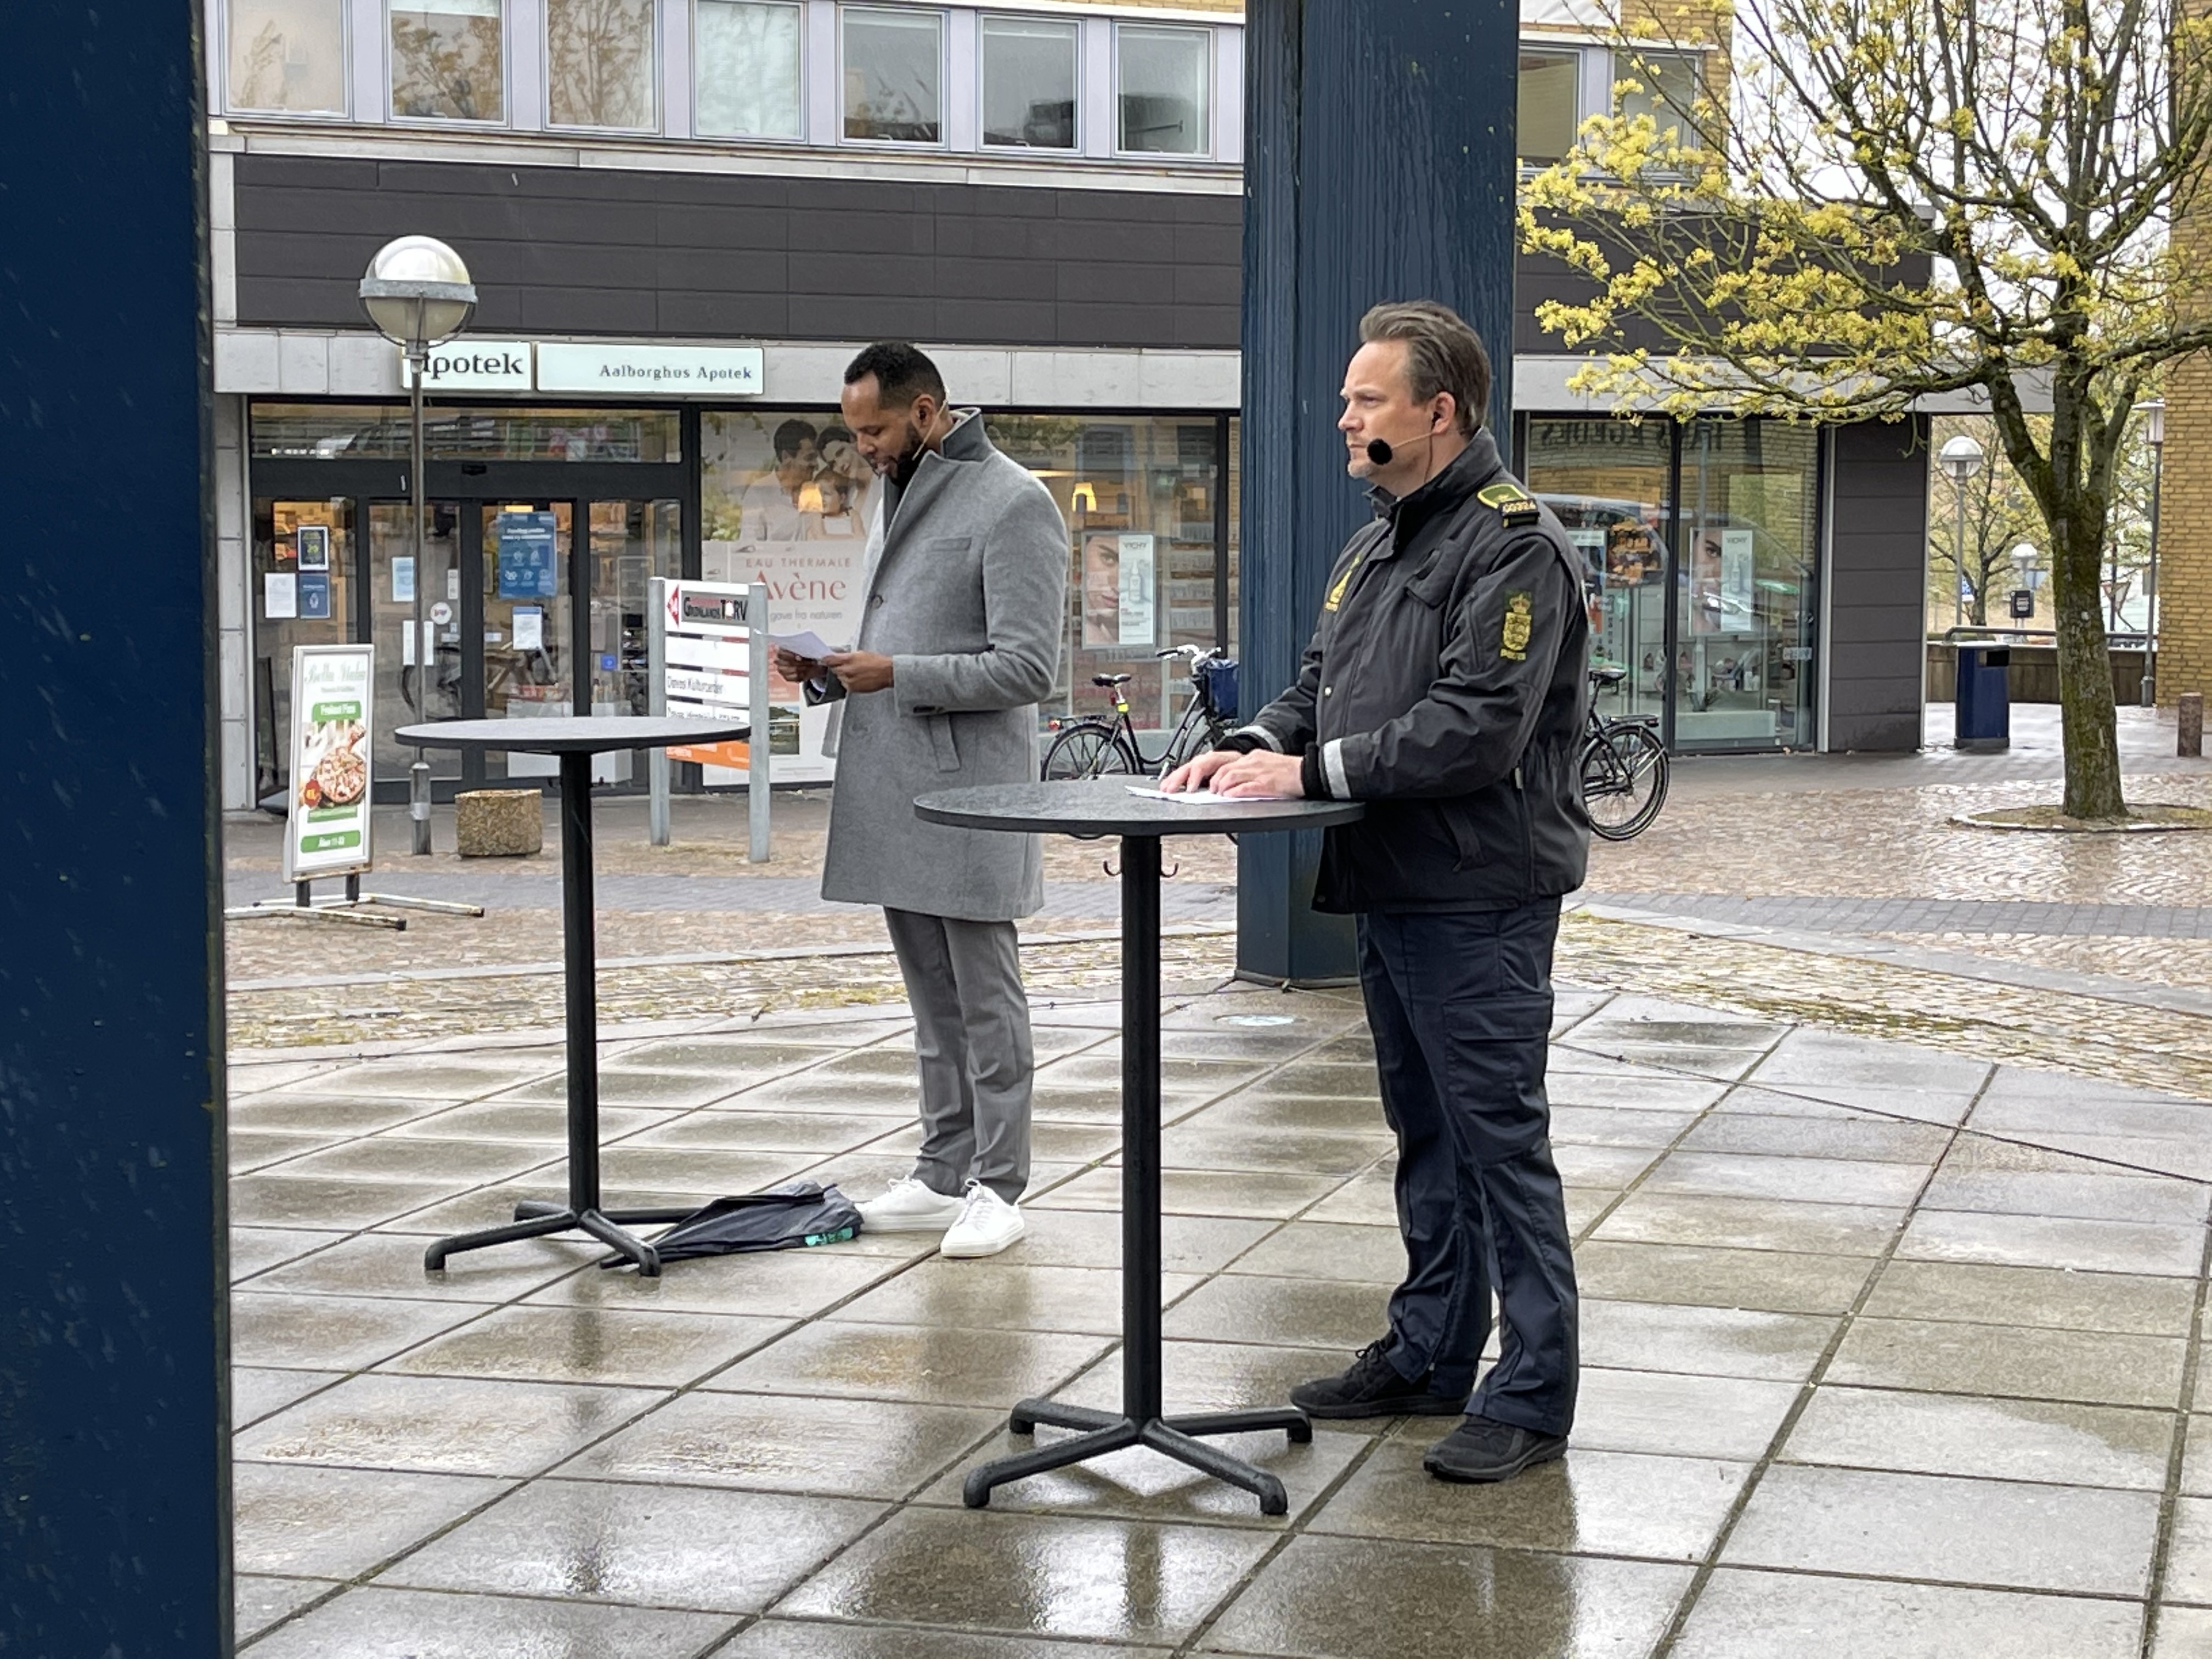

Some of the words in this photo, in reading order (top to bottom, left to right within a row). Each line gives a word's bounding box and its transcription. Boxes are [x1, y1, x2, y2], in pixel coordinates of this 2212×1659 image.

[600, 364, 690, 381] Aalborghus
[697, 366, 752, 381] Apotek
[746, 558, 773, 568] EAU
[781, 557, 851, 568] THERMALE
[755, 570, 847, 601] Avène
